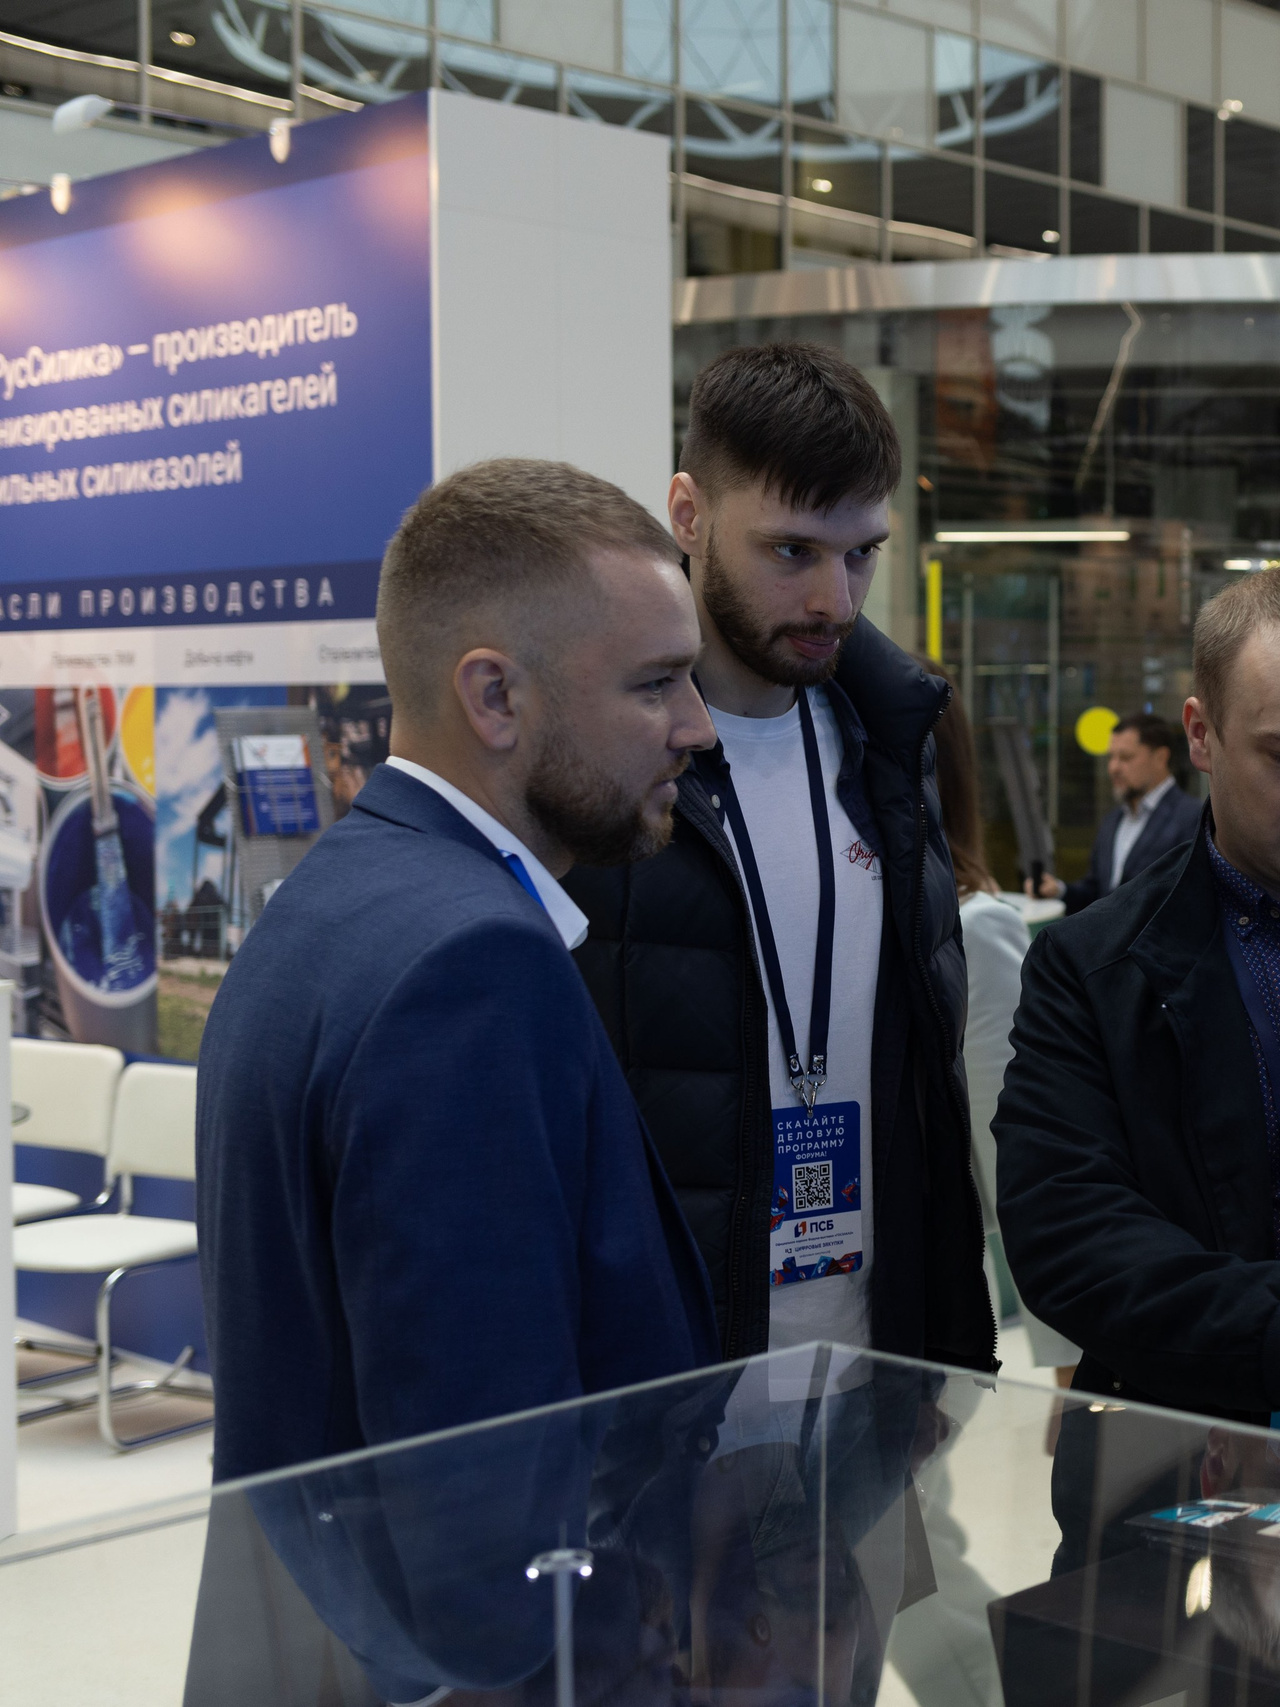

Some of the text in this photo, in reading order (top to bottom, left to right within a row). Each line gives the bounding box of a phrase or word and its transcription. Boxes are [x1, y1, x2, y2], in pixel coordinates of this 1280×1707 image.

[153, 303, 358, 376] производитель
[167, 361, 338, 428] силикагелей
[82, 439, 243, 499] силиказолей
[79, 577, 335, 618] ПРОИЗВОДСТВА
[777, 1115, 845, 1131] СКАЧАЙТЕ
[777, 1127, 845, 1144] ДЕЛОВУЮ
[778, 1138, 845, 1154] ПРОГРАММУ
[795, 1151, 827, 1160] ФОРУМА!
[810, 1219, 834, 1233] ПСБ
